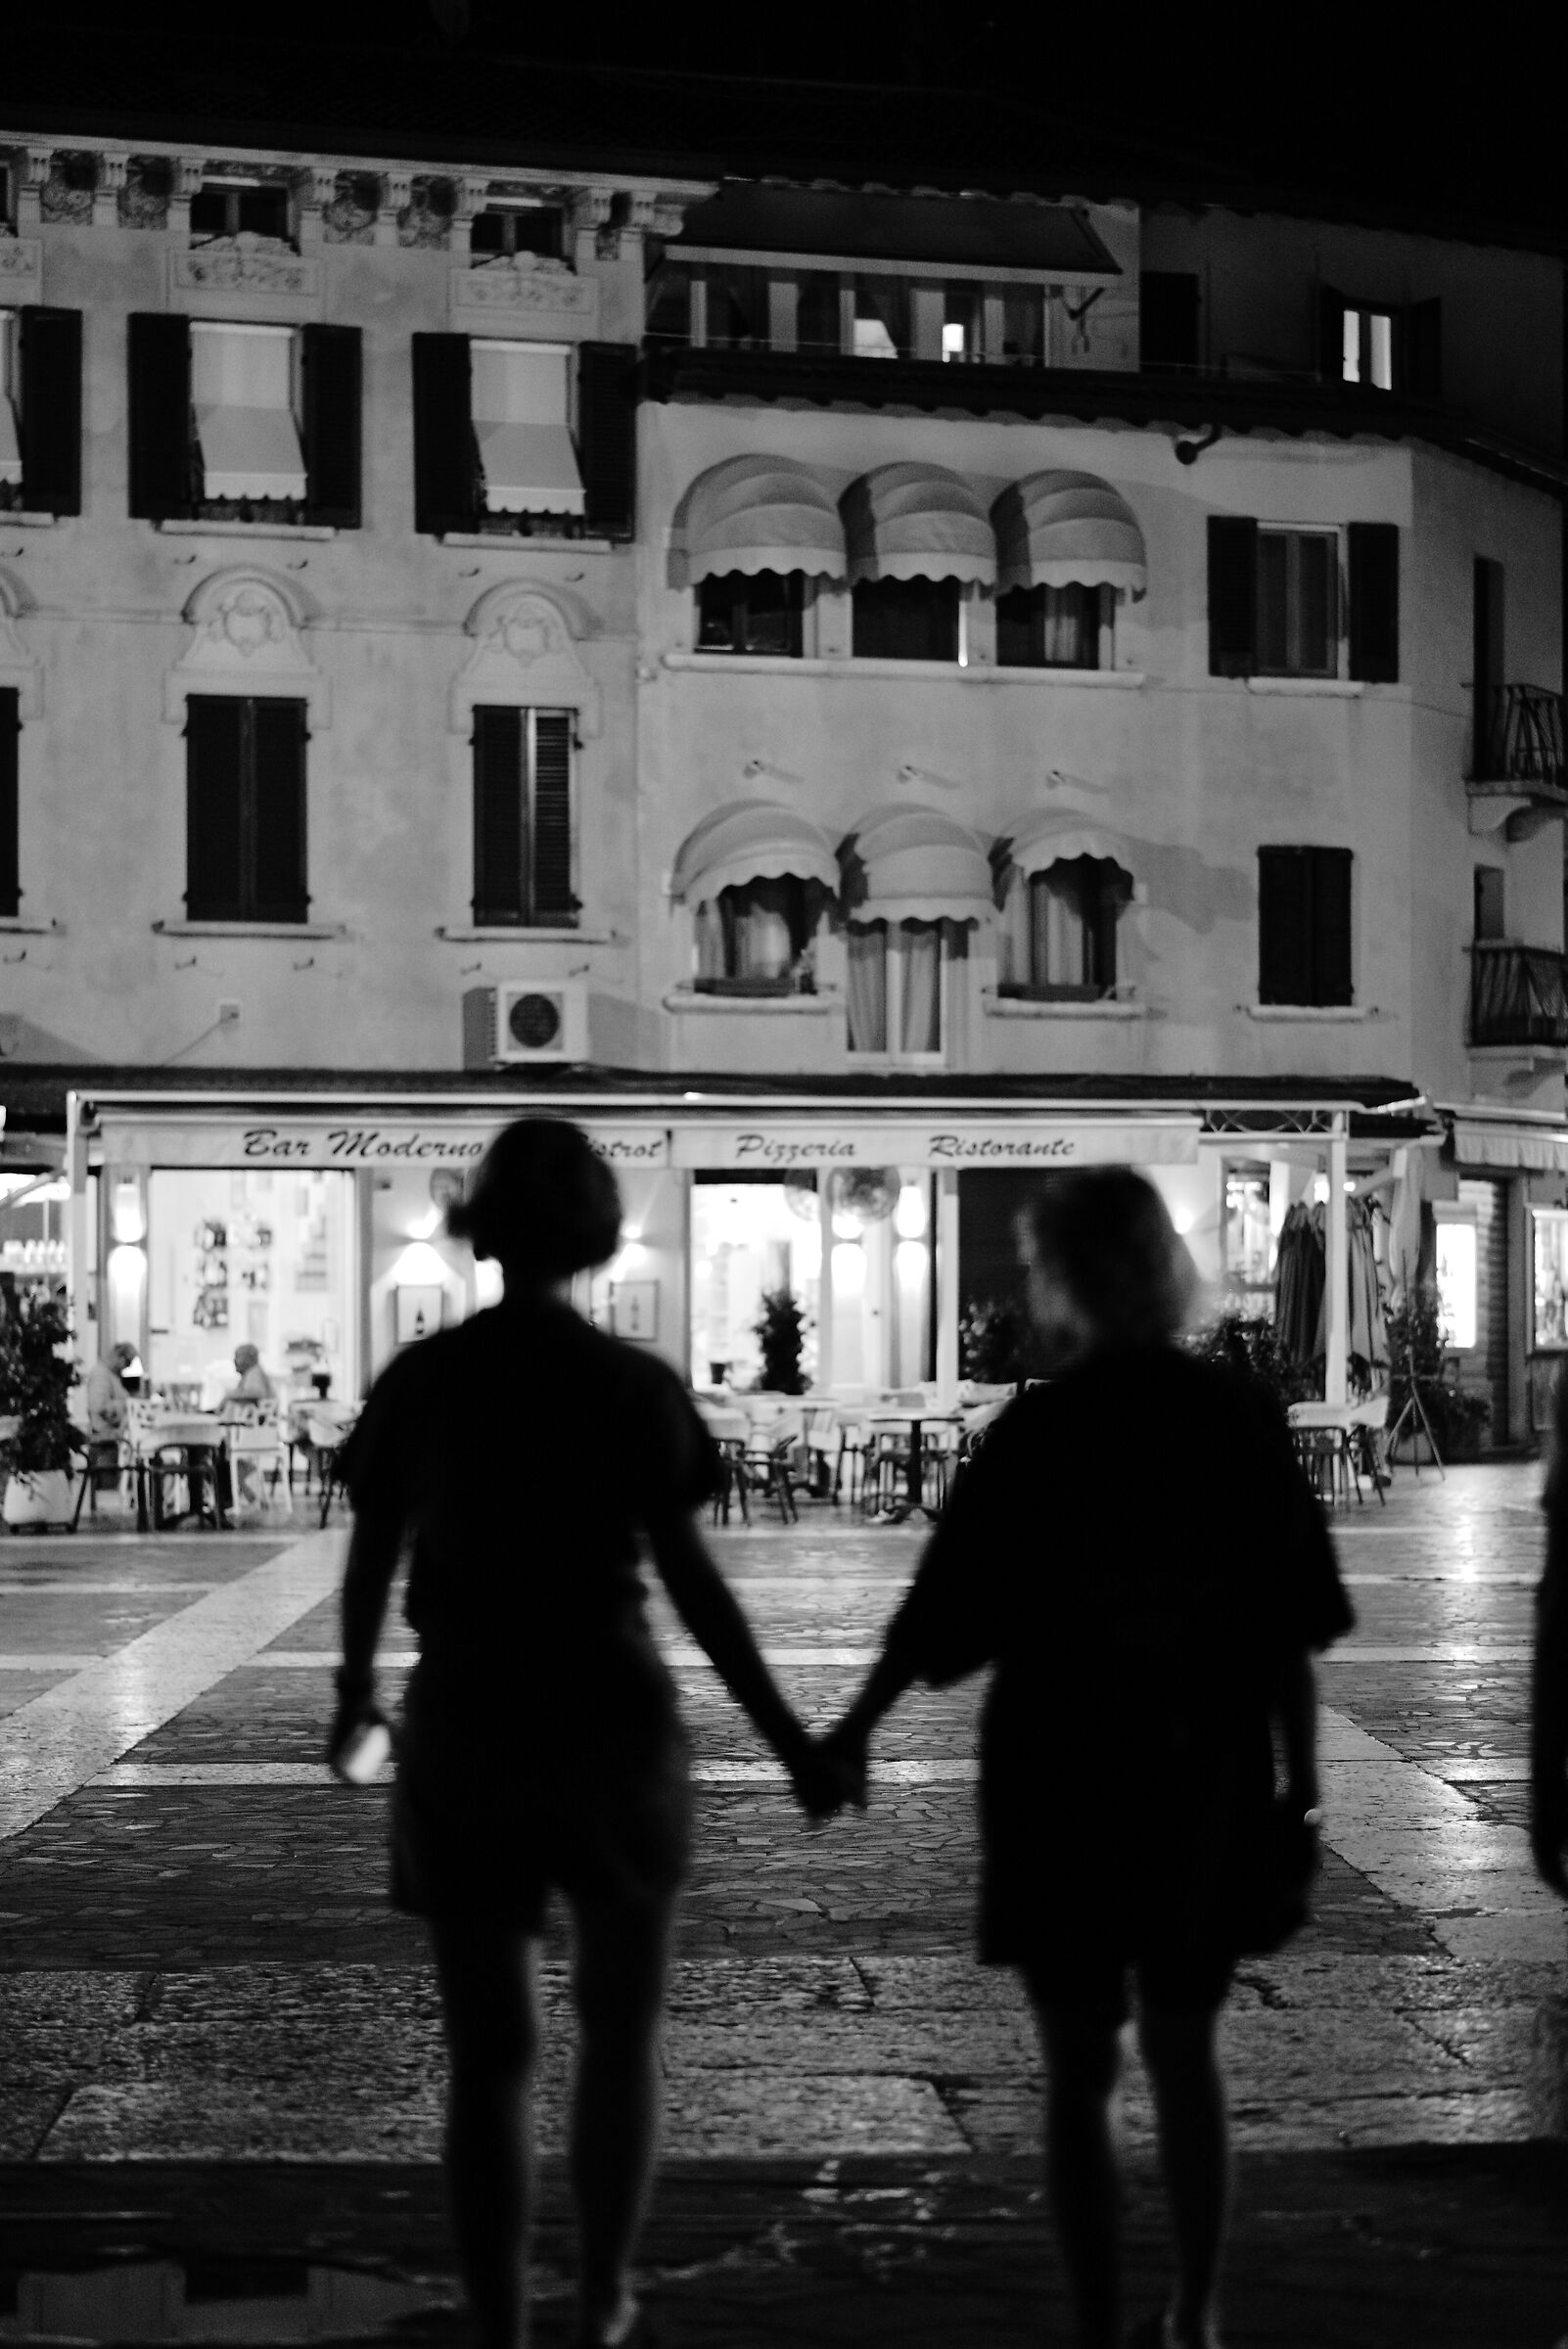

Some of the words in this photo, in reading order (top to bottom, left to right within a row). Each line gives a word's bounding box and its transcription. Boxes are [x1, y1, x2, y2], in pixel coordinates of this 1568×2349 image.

[244, 1128, 309, 1156] Bar
[327, 1130, 484, 1158] Moderno
[586, 1137, 663, 1158] istrot
[735, 1133, 855, 1164] Pizzeria
[929, 1133, 1075, 1157] Ristorante
